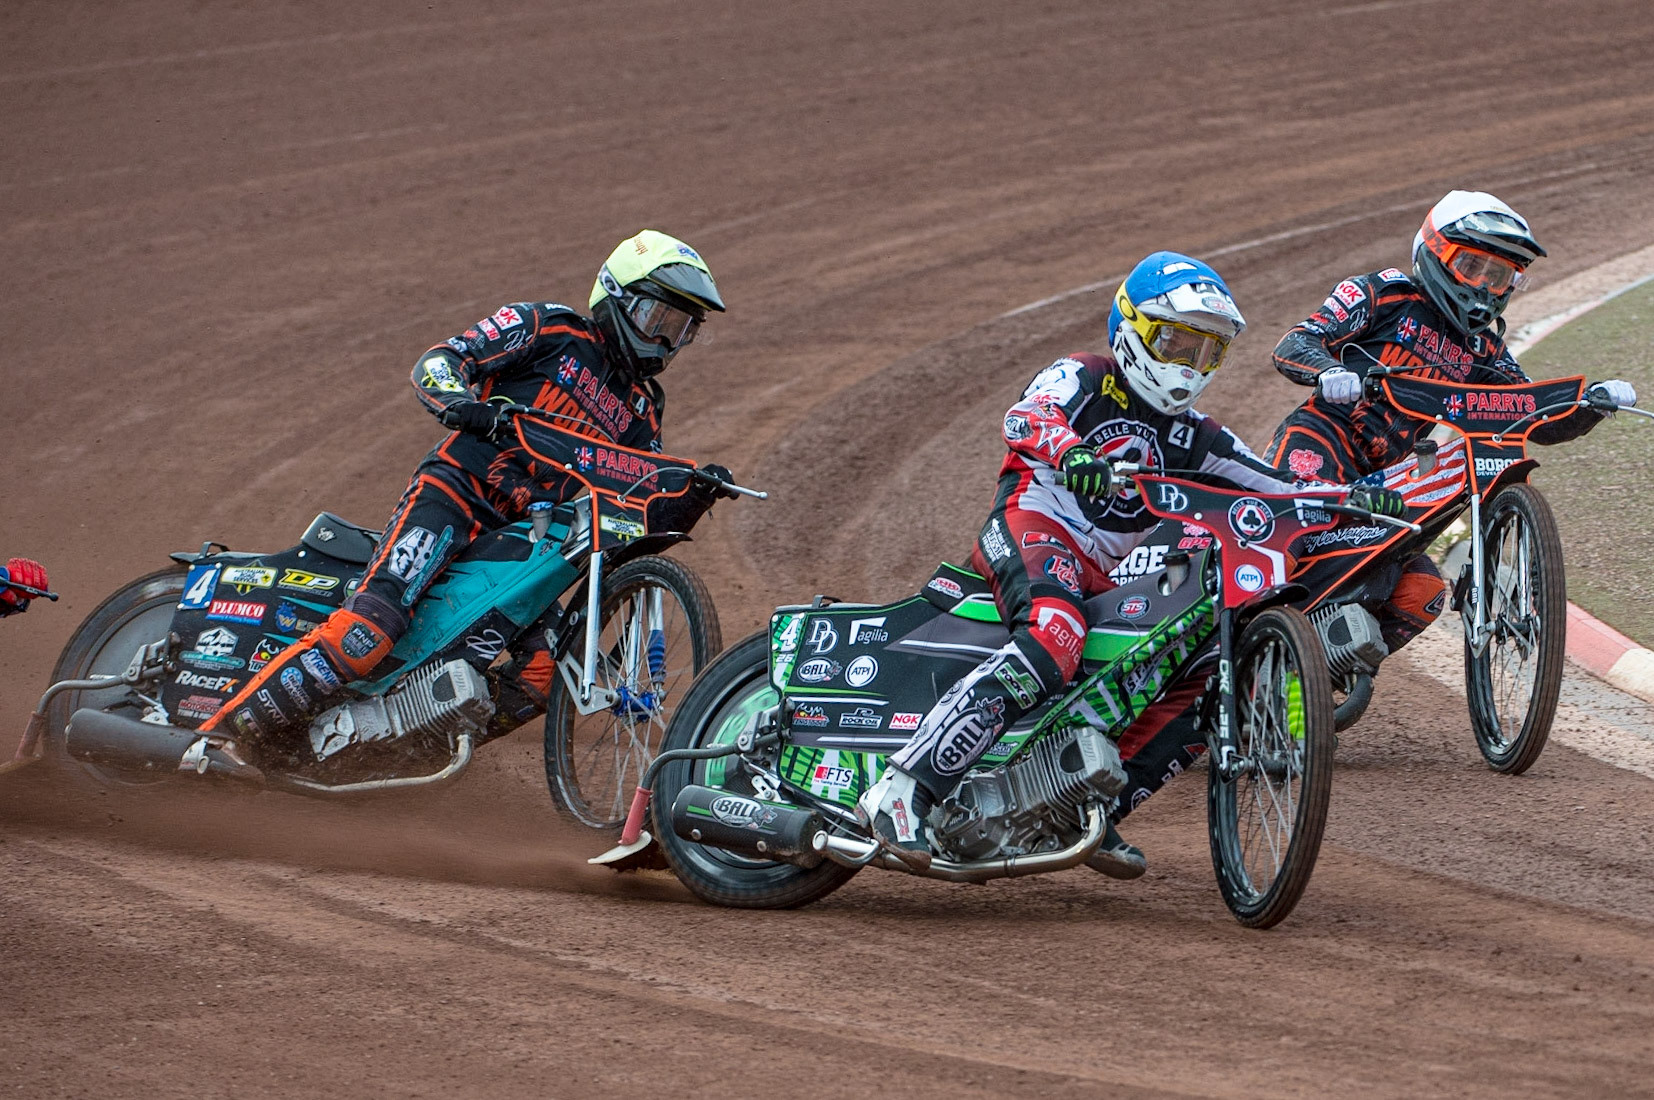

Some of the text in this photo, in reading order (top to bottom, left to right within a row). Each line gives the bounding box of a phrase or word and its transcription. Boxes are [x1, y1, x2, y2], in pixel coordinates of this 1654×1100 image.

[1473, 335, 1482, 353] 3
[577, 366, 634, 433] PARRYS
[635, 396, 646, 415] 4
[1465, 392, 1537, 413] PARRYS
[1093, 423, 1130, 444] BELLE
[1172, 425, 1191, 447] 4
[596, 448, 660, 483] PARRYS
[1304, 509, 1332, 523] agilia
[1177, 537, 1213, 549] GPS
[184, 568, 217, 605] 4
[284, 572, 337, 587] DP
[1240, 573, 1259, 582] ATPI
[210, 600, 266, 618] PLUMCO
[1122, 602, 1144, 612] STS
[352, 627, 375, 649] PNP
[779, 618, 800, 648] 4
[857, 628, 889, 645] agilia
[1048, 623, 1083, 666] agilia
[776, 653, 795, 663] 26
[850, 666, 872, 676] ATPI
[1000, 668, 1024, 695] ROCK
[892, 714, 921, 724] NGK
[826, 767, 853, 783] FTS
